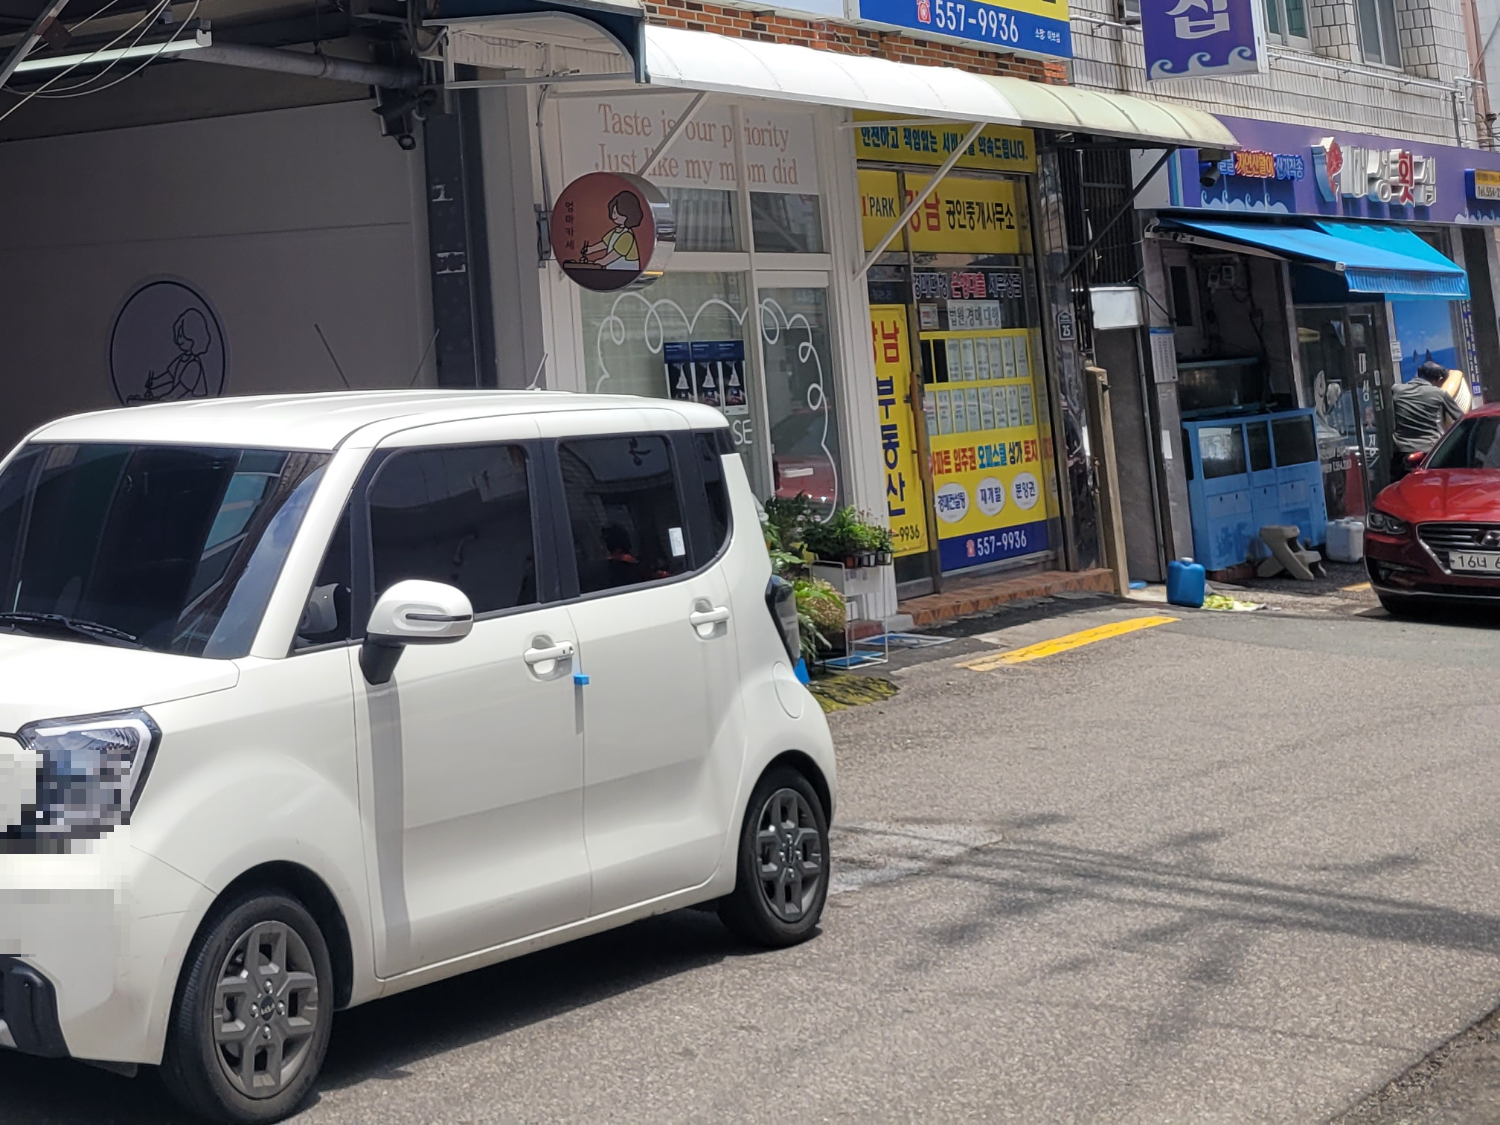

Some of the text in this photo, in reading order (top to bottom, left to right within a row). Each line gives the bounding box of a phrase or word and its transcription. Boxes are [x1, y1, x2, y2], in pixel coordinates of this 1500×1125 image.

[597, 103, 652, 137] Taste
[685, 120, 716, 142] our
[721, 118, 790, 153] piority
[861, 126, 900, 150] 안전하고
[595, 143, 638, 173] Just
[684, 159, 713, 184] my
[719, 161, 768, 184] mm
[772, 157, 799, 185] did
[944, 198, 1016, 232] 공인중개사무소
[1008, 441, 1024, 465] 상가
[1023, 438, 1040, 463] 토지
[979, 486, 1002, 505] 재개발
[1014, 480, 1037, 499] 분양권
[976, 528, 1028, 557] 557-9936
